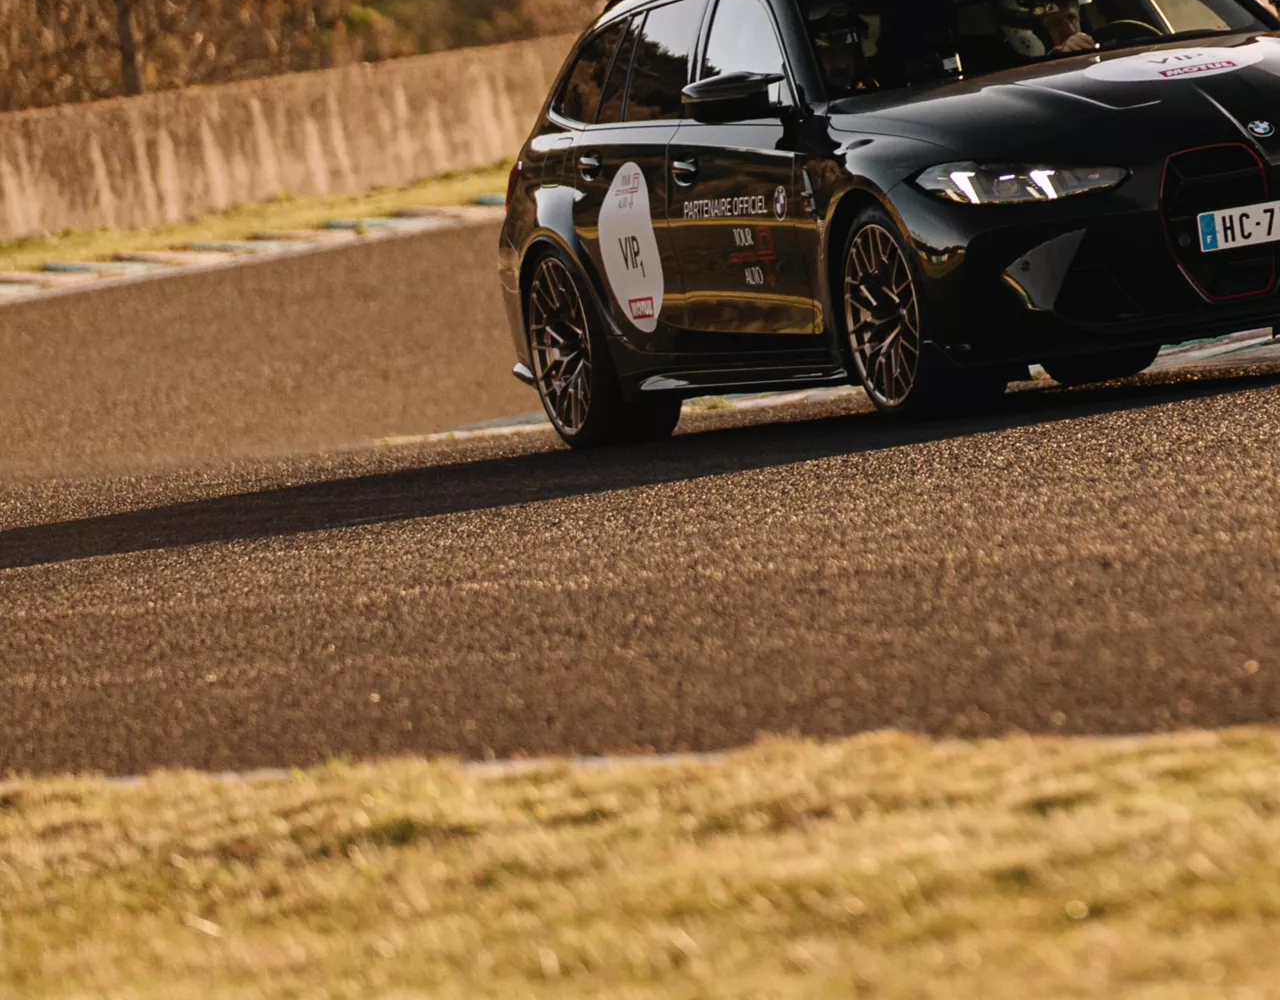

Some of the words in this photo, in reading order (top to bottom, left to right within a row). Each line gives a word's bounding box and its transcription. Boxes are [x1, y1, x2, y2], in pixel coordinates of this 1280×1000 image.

[1165, 61, 1234, 76] MOTUL
[683, 198, 732, 218] PARTENAIRE
[732, 195, 768, 215] OFFICIEL
[733, 227, 754, 246] TOUR
[1206, 235, 1212, 244] F
[618, 235, 640, 270] VIP
